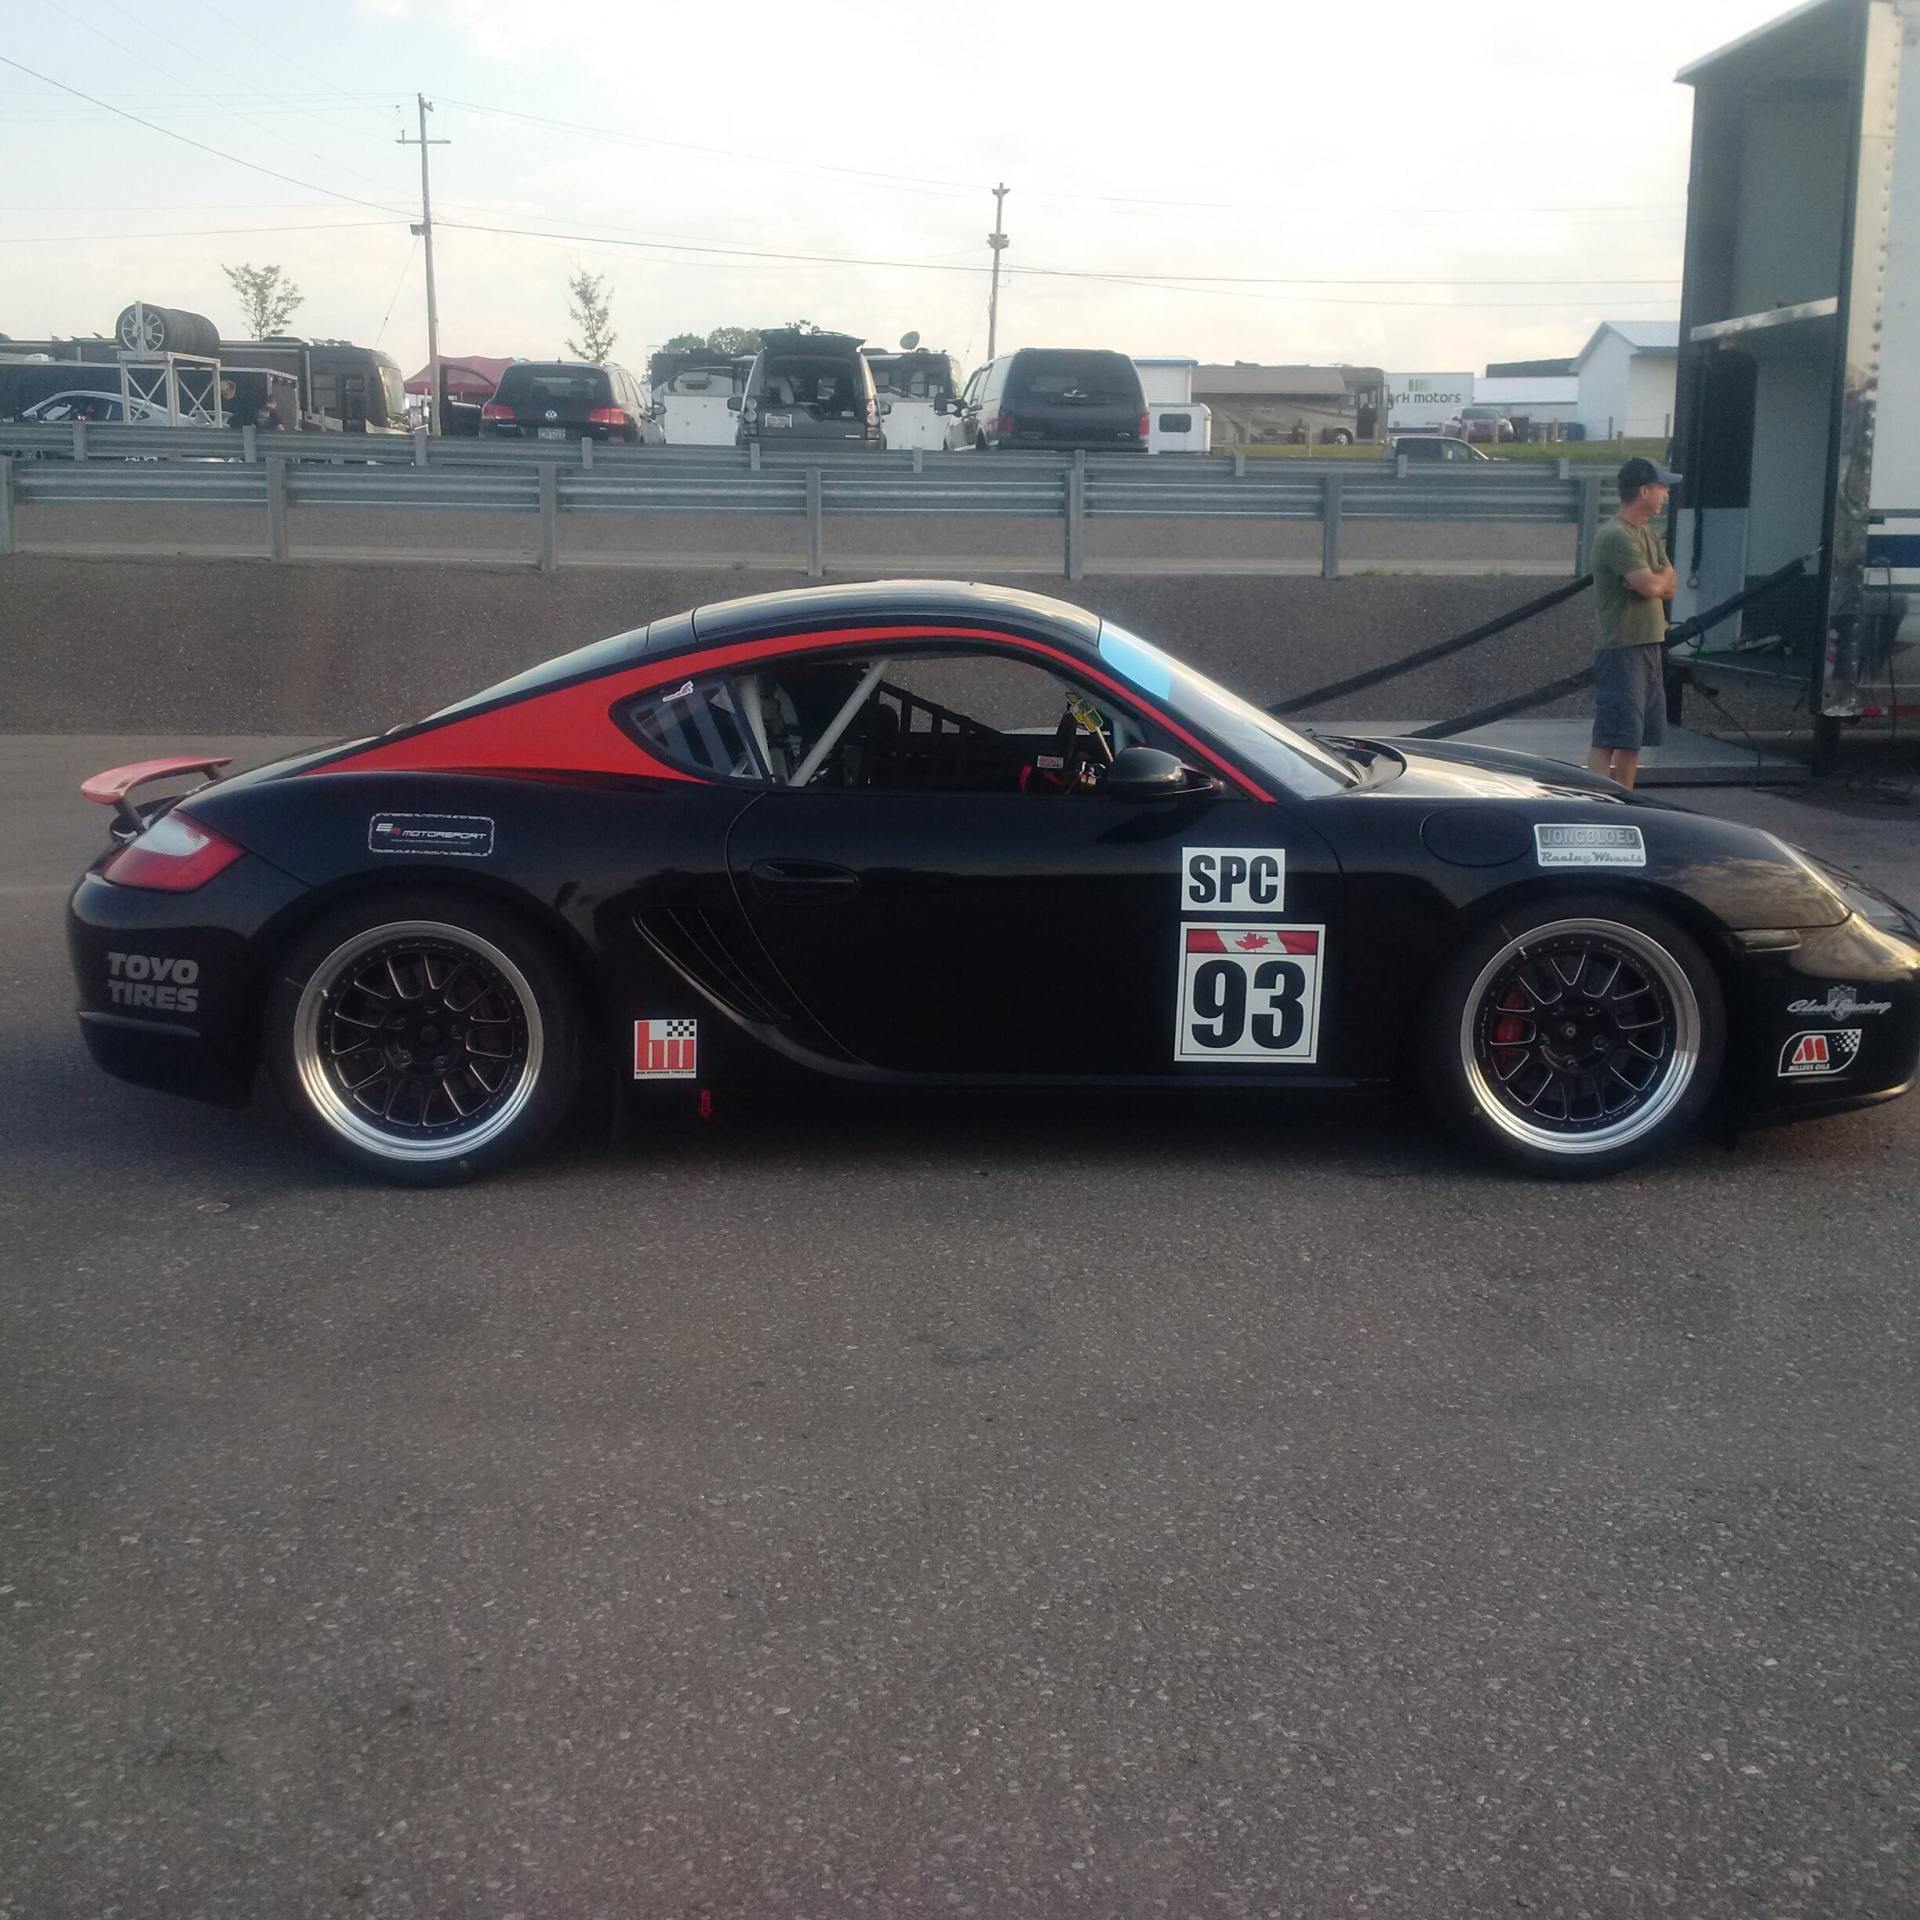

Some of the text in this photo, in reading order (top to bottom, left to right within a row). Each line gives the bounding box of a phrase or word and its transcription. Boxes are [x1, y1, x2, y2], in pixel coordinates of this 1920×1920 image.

[1414, 392, 1462, 403] motors
[402, 830, 487, 839] MOTORSPORT
[1541, 830, 1637, 845] JONGBLOED
[1188, 854, 1279, 905] SPC
[107, 951, 199, 985] TOYO
[107, 979, 200, 1013] TIRES
[1191, 959, 1306, 1050] 93
